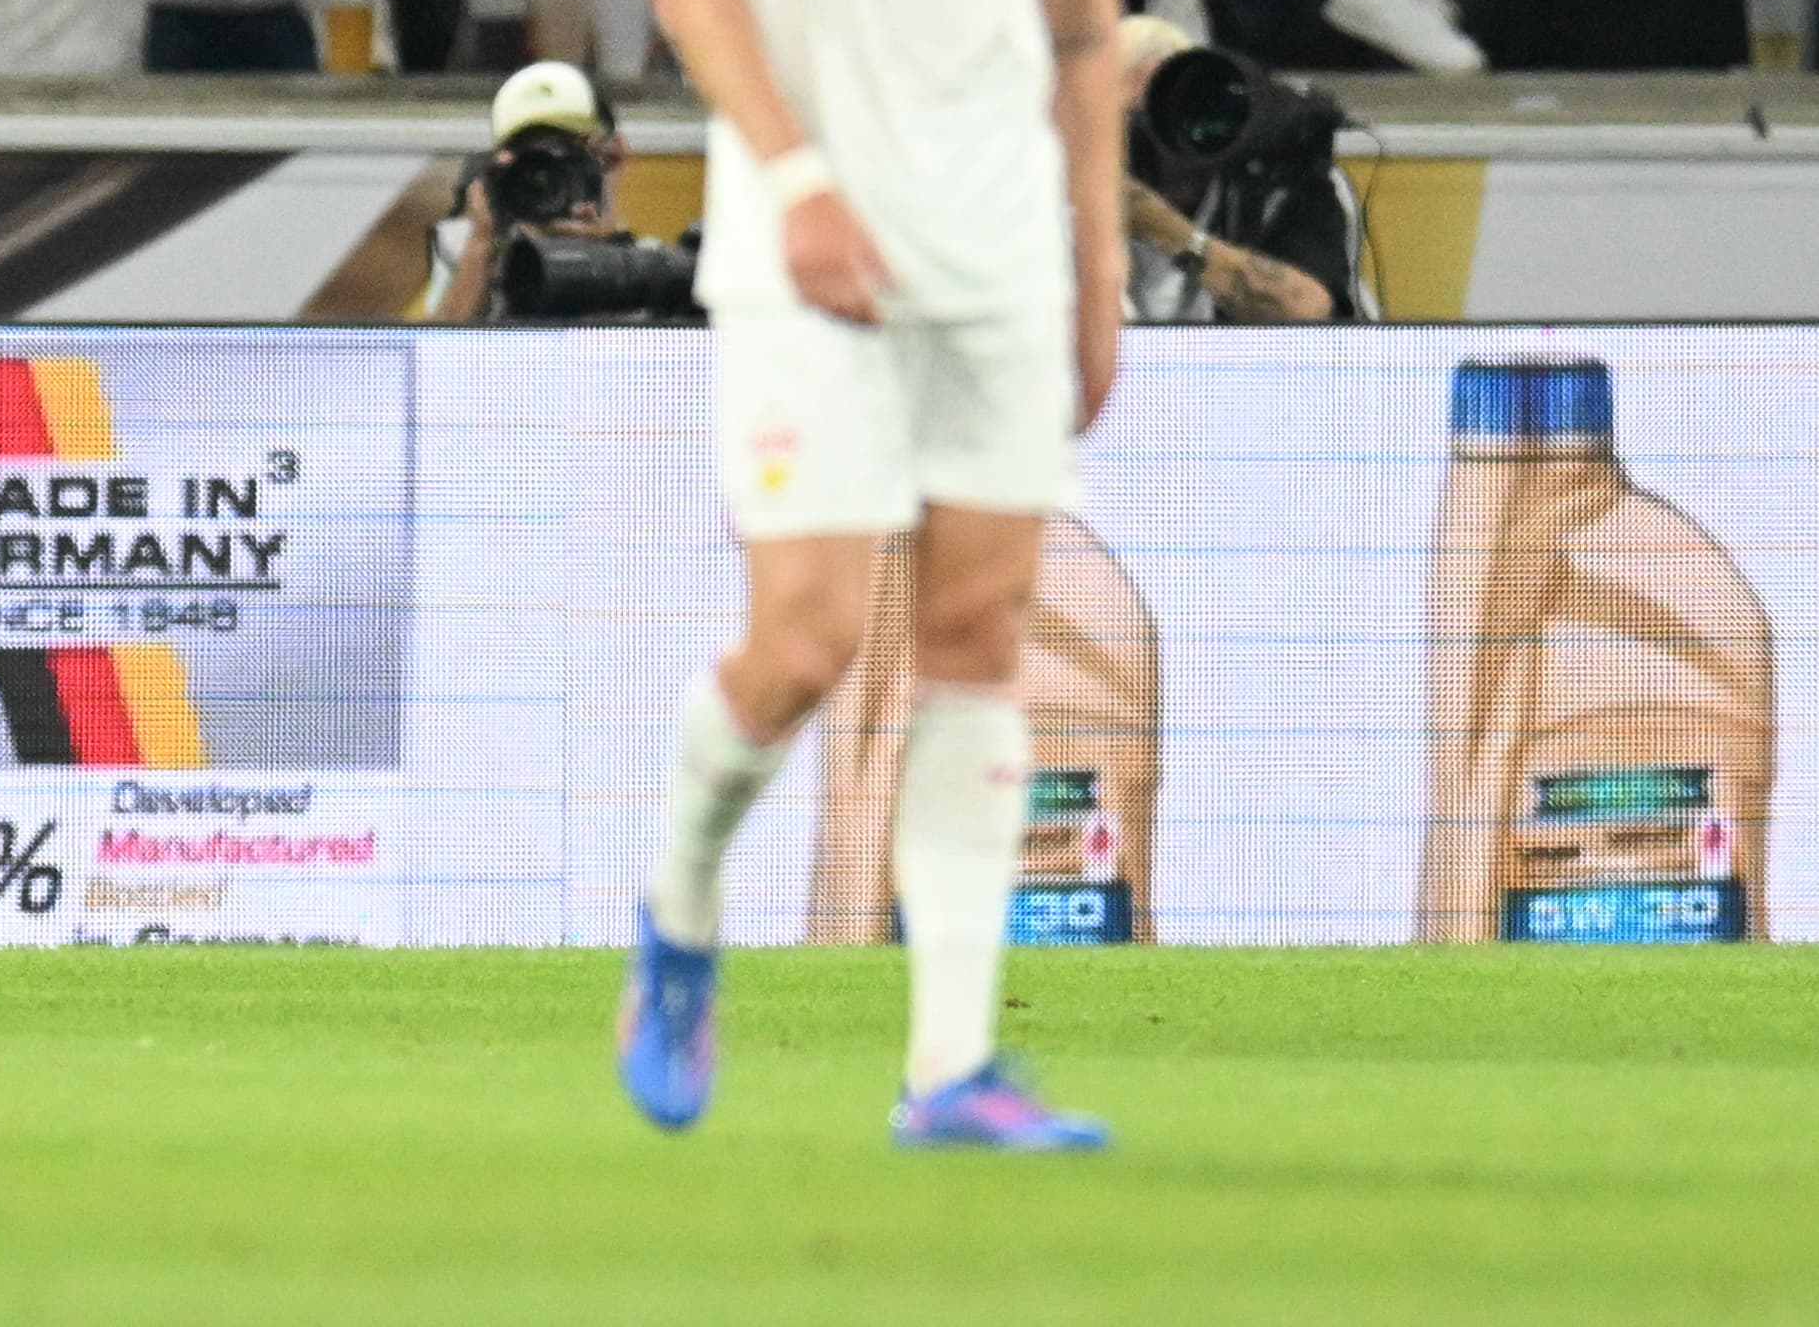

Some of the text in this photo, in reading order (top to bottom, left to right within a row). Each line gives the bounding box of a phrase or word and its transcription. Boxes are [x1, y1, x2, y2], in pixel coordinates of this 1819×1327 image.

[184, 477, 258, 519] IN
[113, 780, 313, 822] Developed
[97, 829, 376, 864] Manufactured
